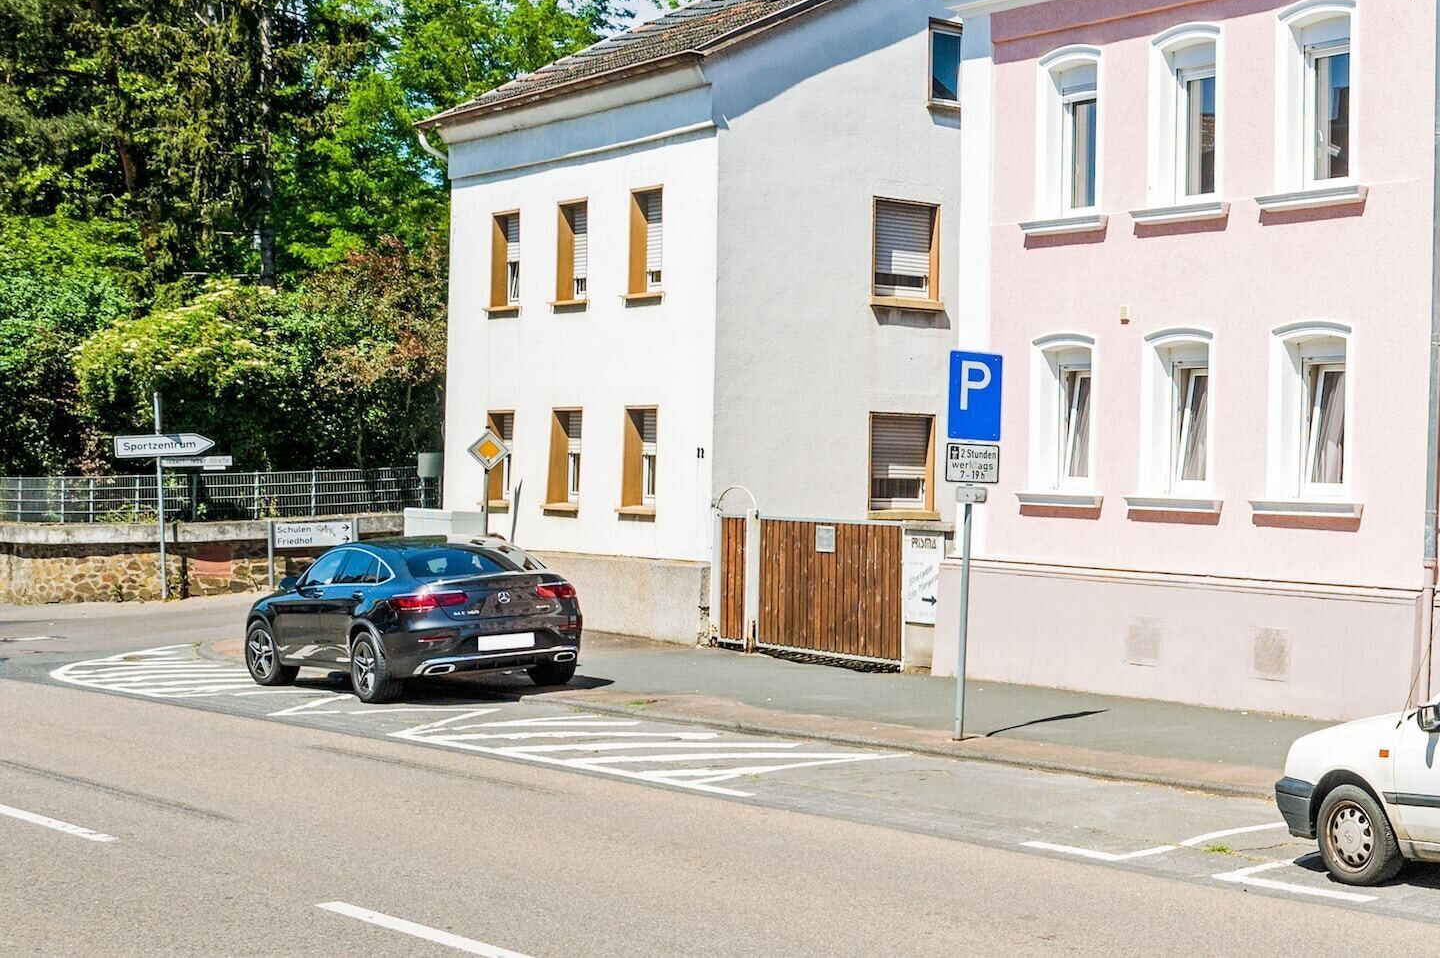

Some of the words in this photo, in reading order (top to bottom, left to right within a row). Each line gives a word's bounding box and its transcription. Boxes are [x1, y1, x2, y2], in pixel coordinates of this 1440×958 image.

[959, 360, 992, 411] P
[123, 441, 196, 453] Sportzentrum
[960, 448, 966, 458] 2
[966, 449, 997, 460] Stunden
[277, 526, 312, 534] Schulen
[277, 537, 313, 545] Friedhof
